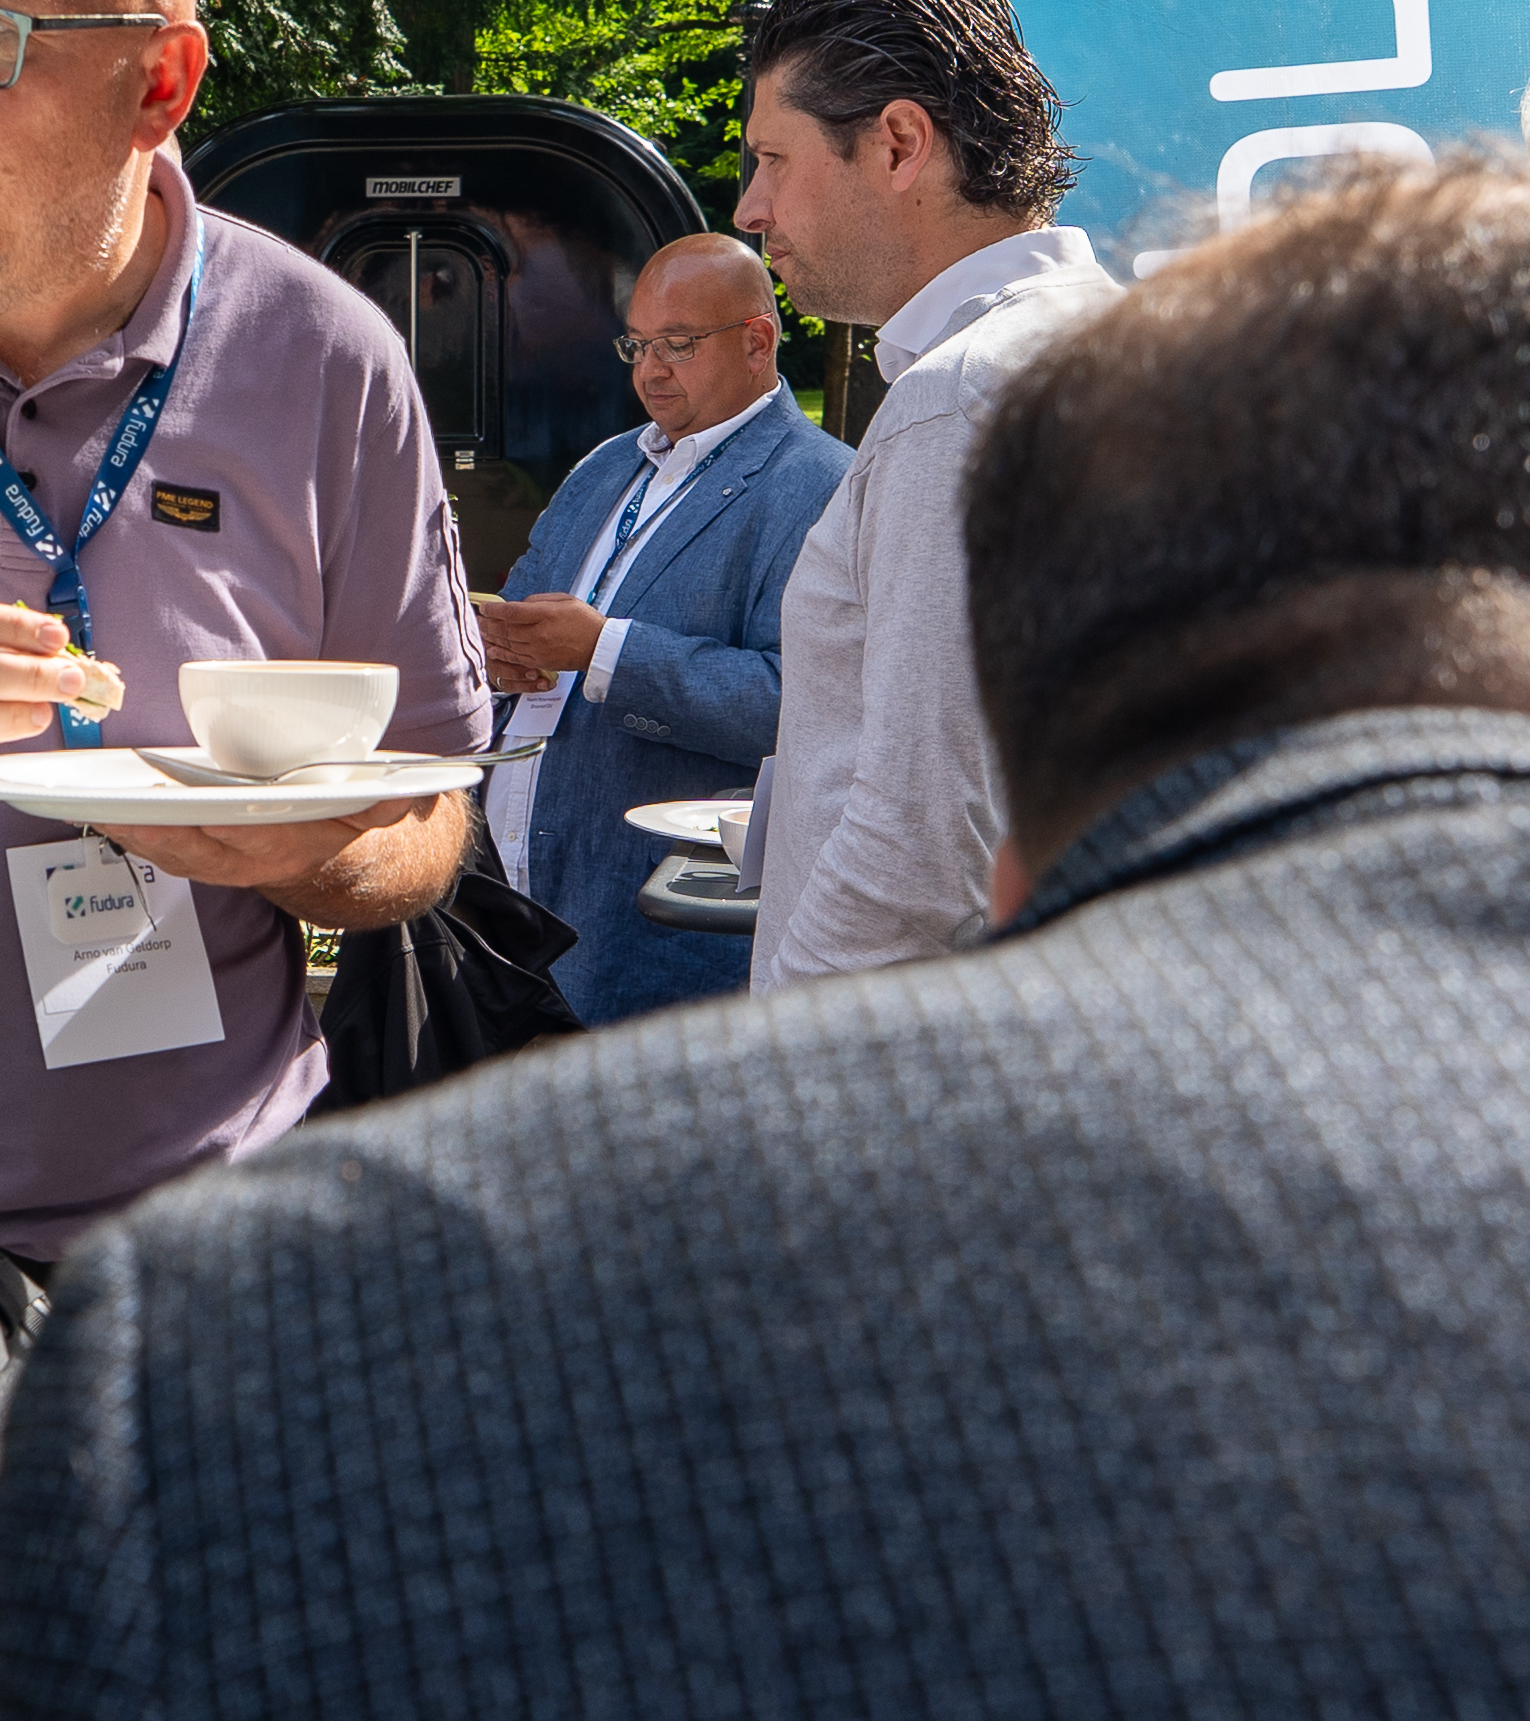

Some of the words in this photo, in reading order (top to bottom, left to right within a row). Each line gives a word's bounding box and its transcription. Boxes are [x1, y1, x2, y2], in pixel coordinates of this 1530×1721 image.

[110, 416, 147, 468] fudura
[5, 483, 45, 537] fudura
[89, 894, 135, 913] fudura
[73, 949, 101, 961] Arno
[102, 946, 123, 957] van
[106, 959, 147, 975] Fudura
